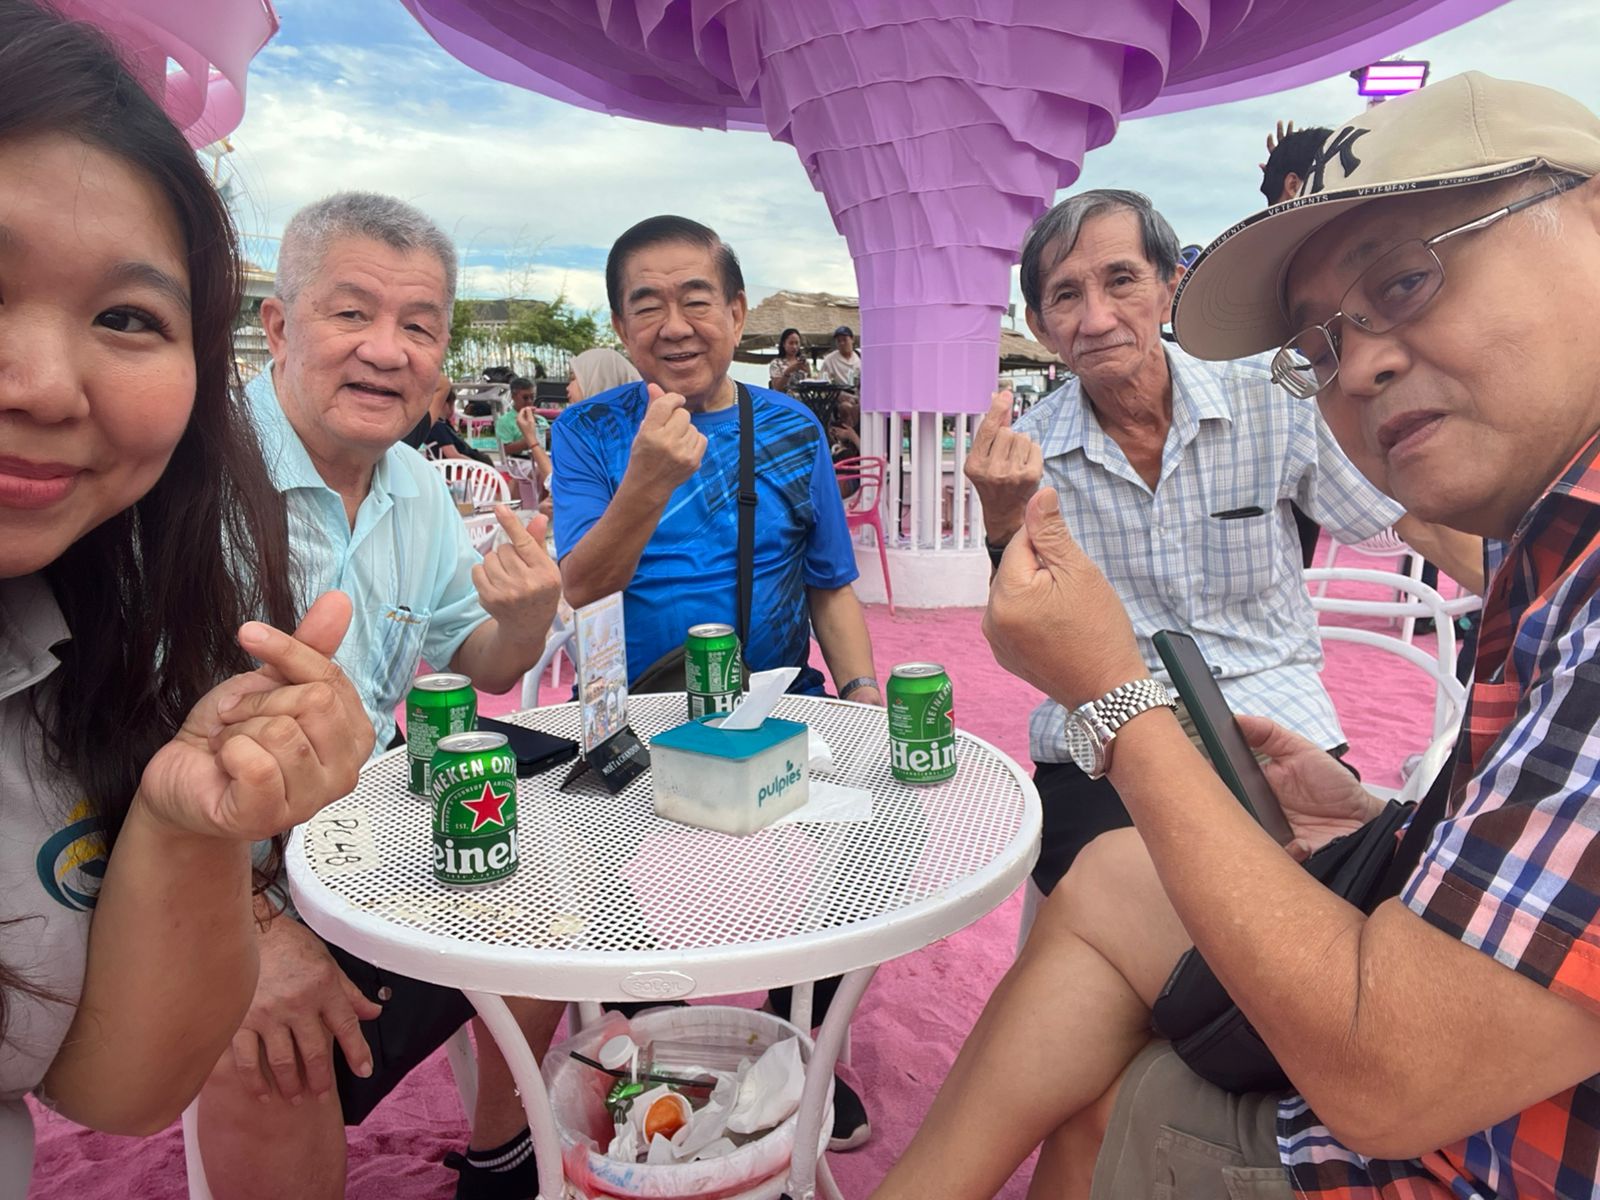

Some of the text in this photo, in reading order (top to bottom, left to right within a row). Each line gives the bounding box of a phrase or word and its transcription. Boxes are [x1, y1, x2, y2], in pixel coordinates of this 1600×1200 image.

[1358, 182, 1417, 196] VETEMENTS
[1268, 194, 1329, 216] VETEMENTS
[758, 760, 801, 808] pulpies
